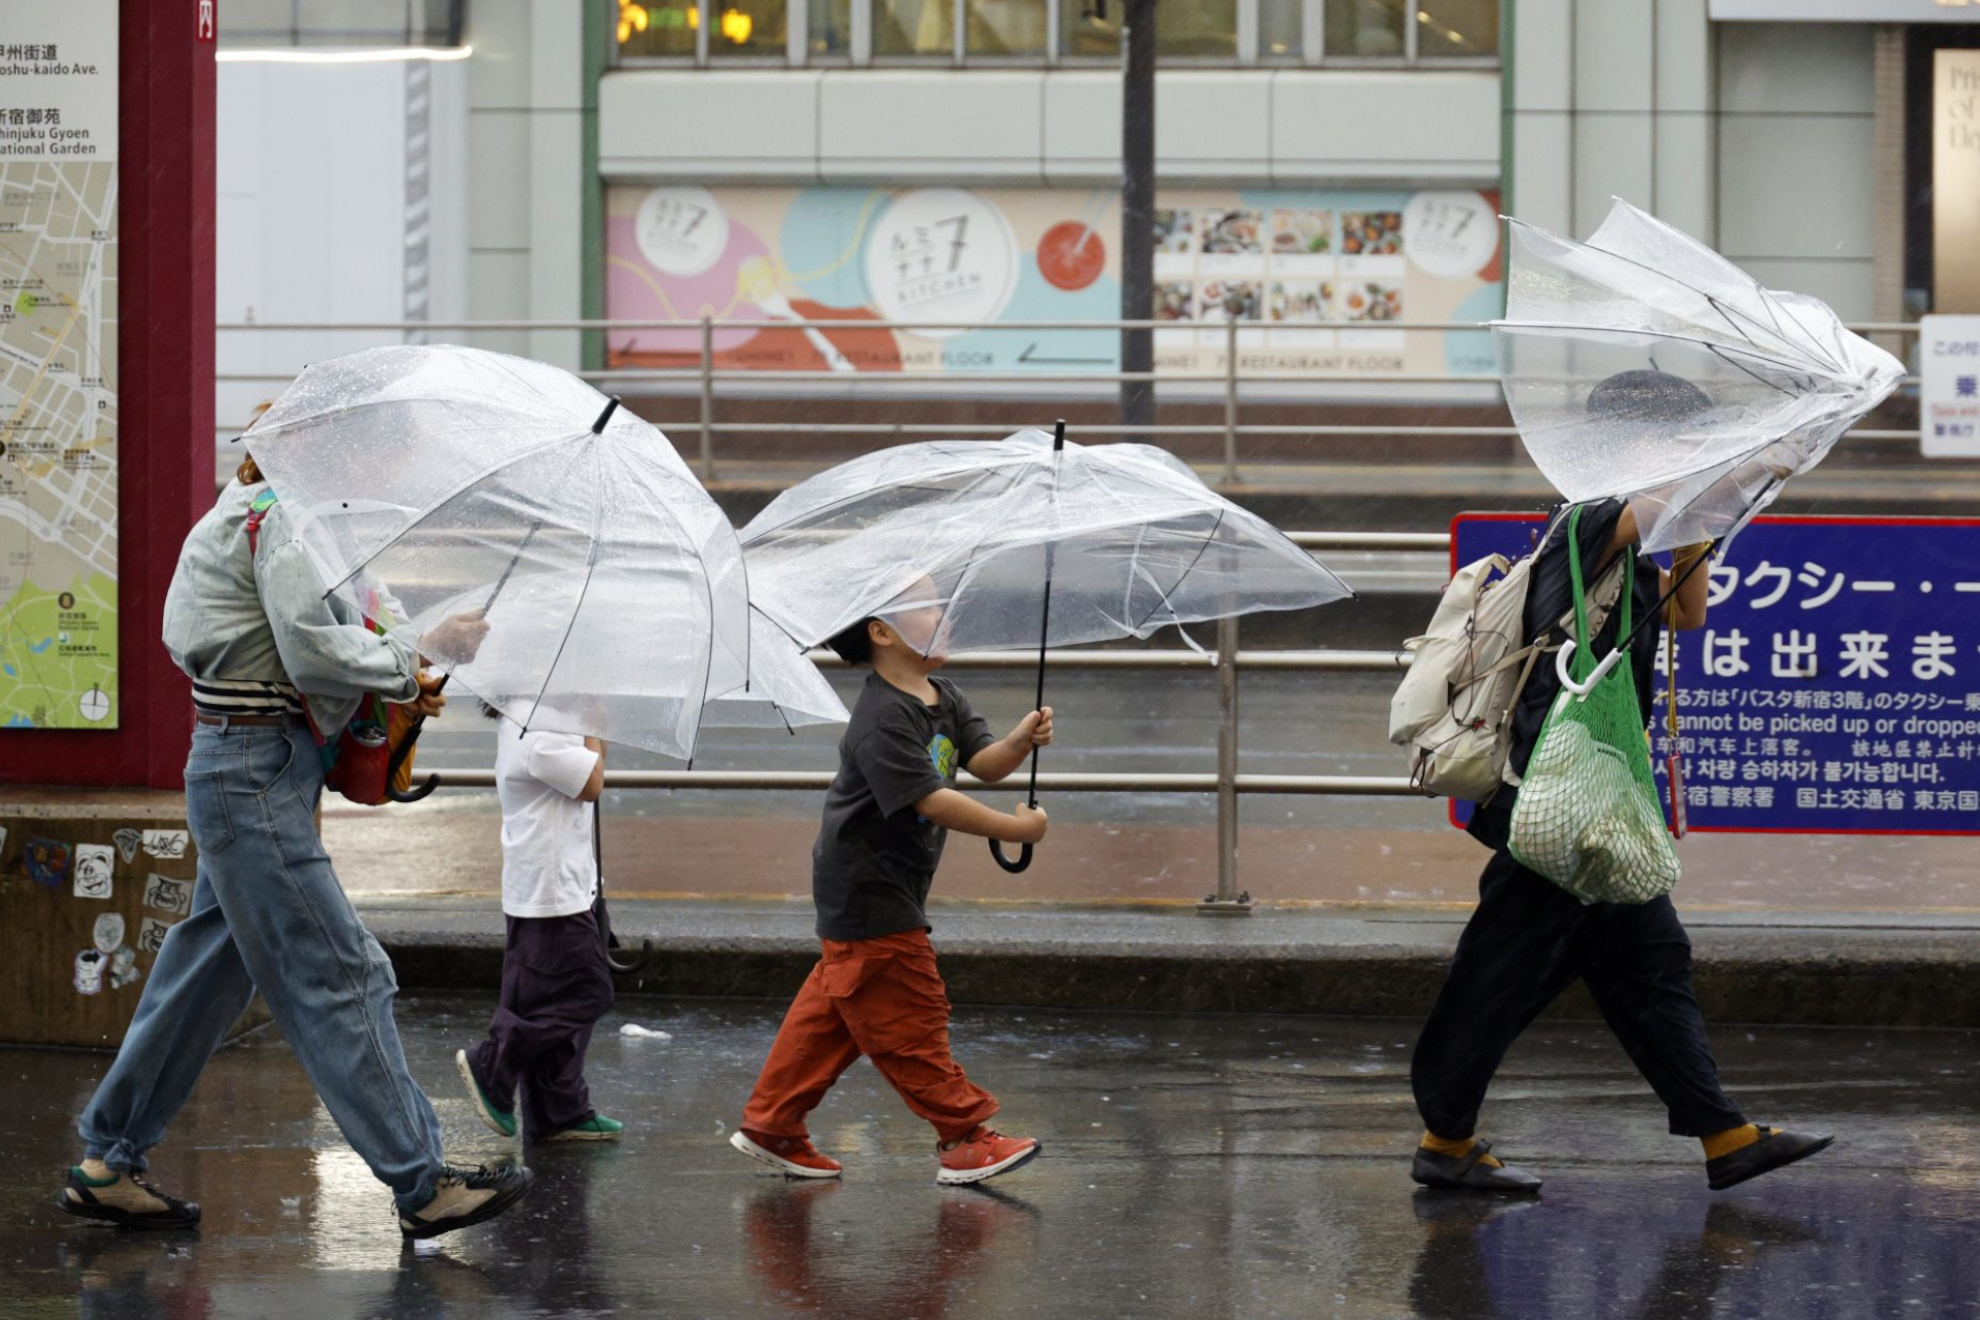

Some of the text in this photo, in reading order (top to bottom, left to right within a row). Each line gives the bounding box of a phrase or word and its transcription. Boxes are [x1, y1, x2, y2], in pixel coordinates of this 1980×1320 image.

[0, 45, 58, 61] 州街道
[0, 63, 99, 76] oshu-kaido Ave.
[0, 127, 90, 143] hinjuku Gyoen
[0, 142, 97, 155] ational Garden
[940, 351, 995, 367] FLOOR
[1239, 354, 1342, 370] RESTAURANT
[1348, 355, 1404, 371] FLOOR
[1653, 628, 1980, 680] は出来ま
[1662, 715, 1733, 732] cannot
[1739, 713, 1764, 732] be
[1770, 713, 1837, 736] picked
[1843, 718, 1869, 738] up
[1875, 718, 1898, 734] or
[1903, 715, 1980, 739] droppe
[1648, 737, 1980, 761] 车和汽车上落客。 該地區禁止計
[1697, 758, 1737, 780] 차량
[1741, 760, 1818, 782] 승하차가
[1823, 761, 1945, 784] 불가능합니다.
[1796, 787, 1906, 811] 国土交通省
[1913, 789, 1980, 812] 東京国
